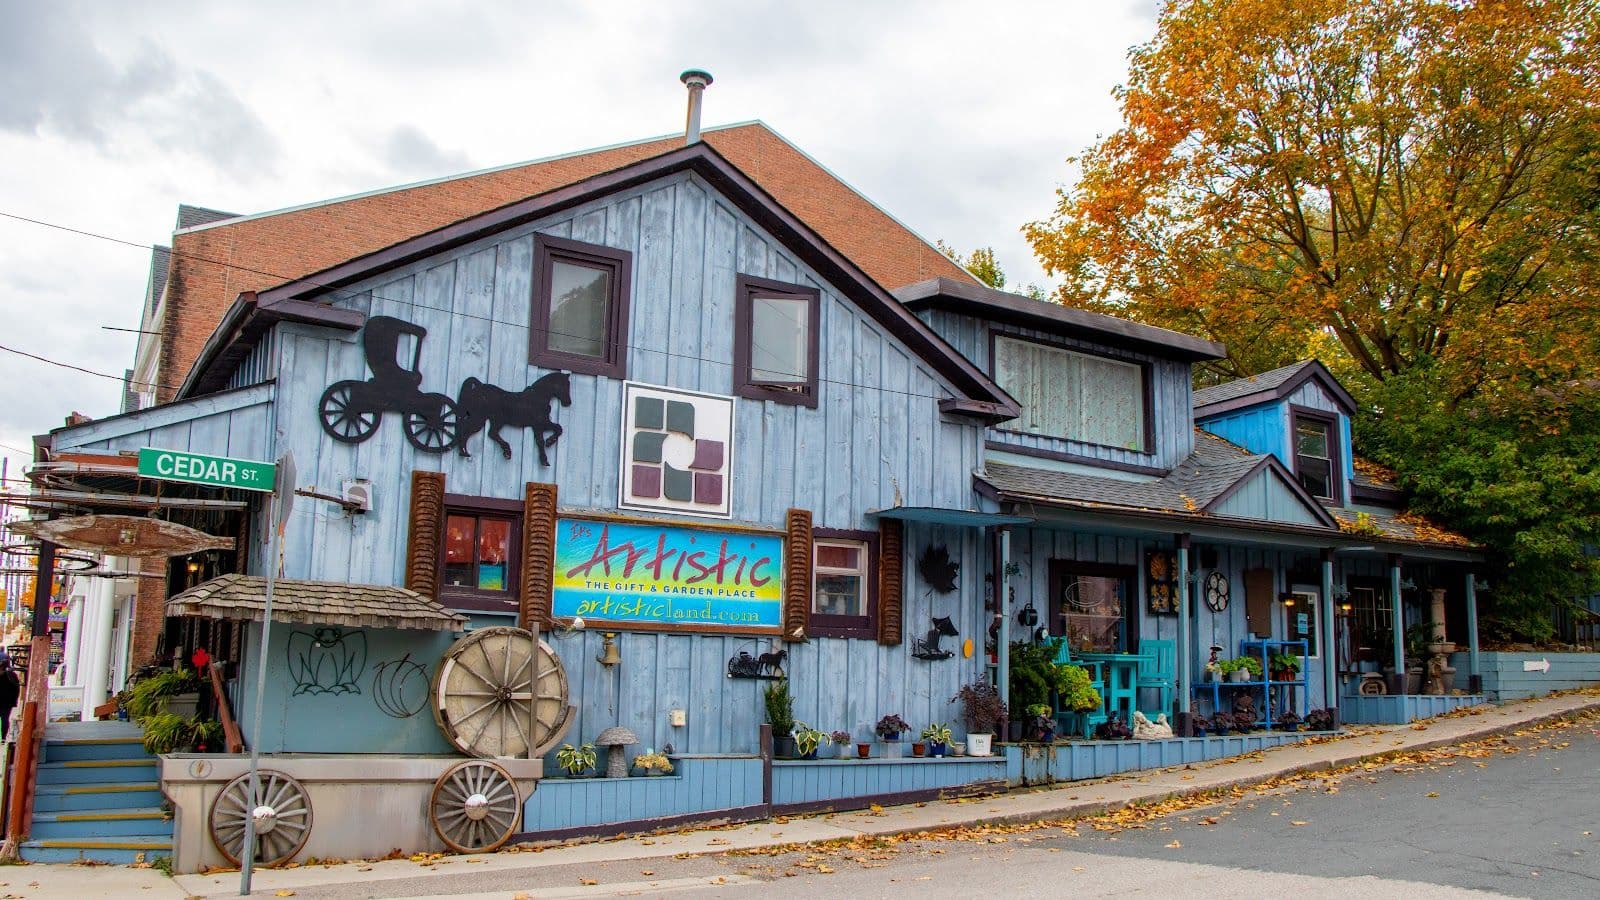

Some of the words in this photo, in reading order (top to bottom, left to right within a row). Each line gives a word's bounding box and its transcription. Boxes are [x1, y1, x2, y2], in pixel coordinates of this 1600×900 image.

[157, 454, 237, 482] CEDAR
[241, 469, 259, 481] ST.
[566, 522, 771, 587] Artistic
[586, 581, 609, 590] THE
[615, 583, 644, 592] GIFT
[650, 585, 657, 593] &
[663, 585, 713, 596] GARDEN
[718, 588, 756, 598] PLACE
[576, 595, 760, 622] artisticland.com
